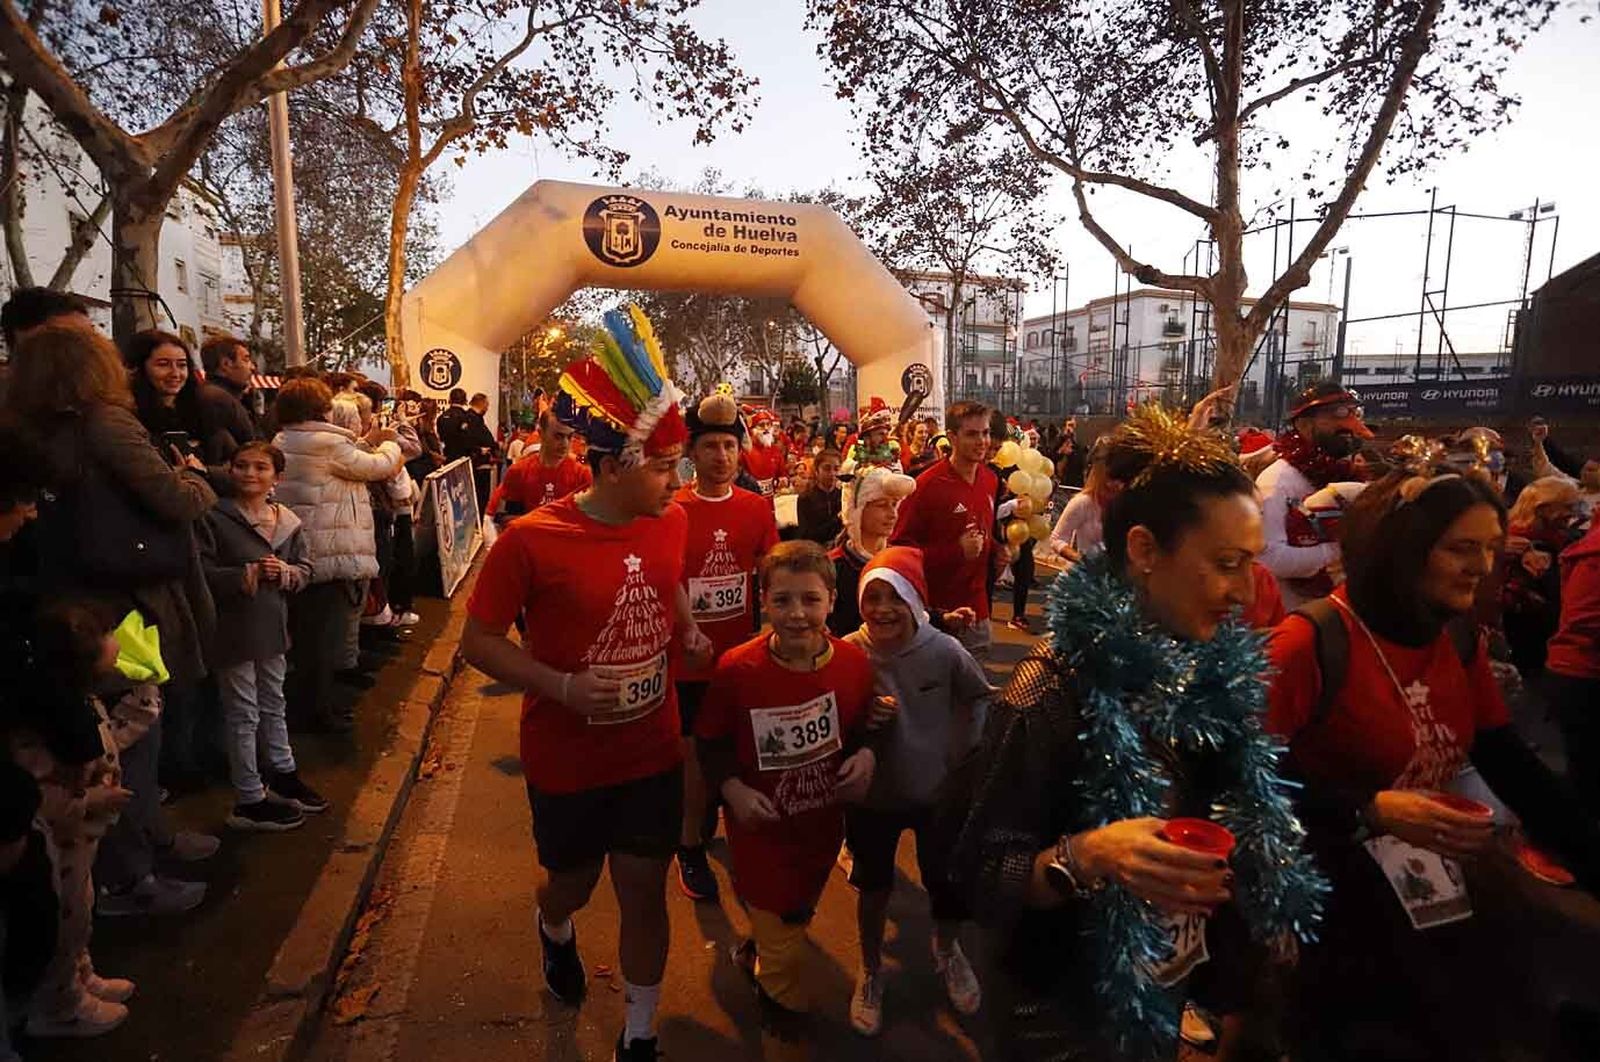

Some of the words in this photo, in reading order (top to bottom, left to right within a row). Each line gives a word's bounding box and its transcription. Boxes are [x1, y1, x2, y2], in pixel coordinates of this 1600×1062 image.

[664, 205, 796, 226] Ayuntamiento
[704, 223, 726, 238] de
[733, 225, 797, 242] Huelva
[734, 244, 747, 253] de
[751, 245, 799, 257] Deportes
[1363, 391, 1409, 401] HYUNDAI
[1443, 388, 1499, 399] HYUNDAI
[715, 587, 742, 608] 392
[627, 672, 661, 704] 390
[791, 716, 830, 748] 389
